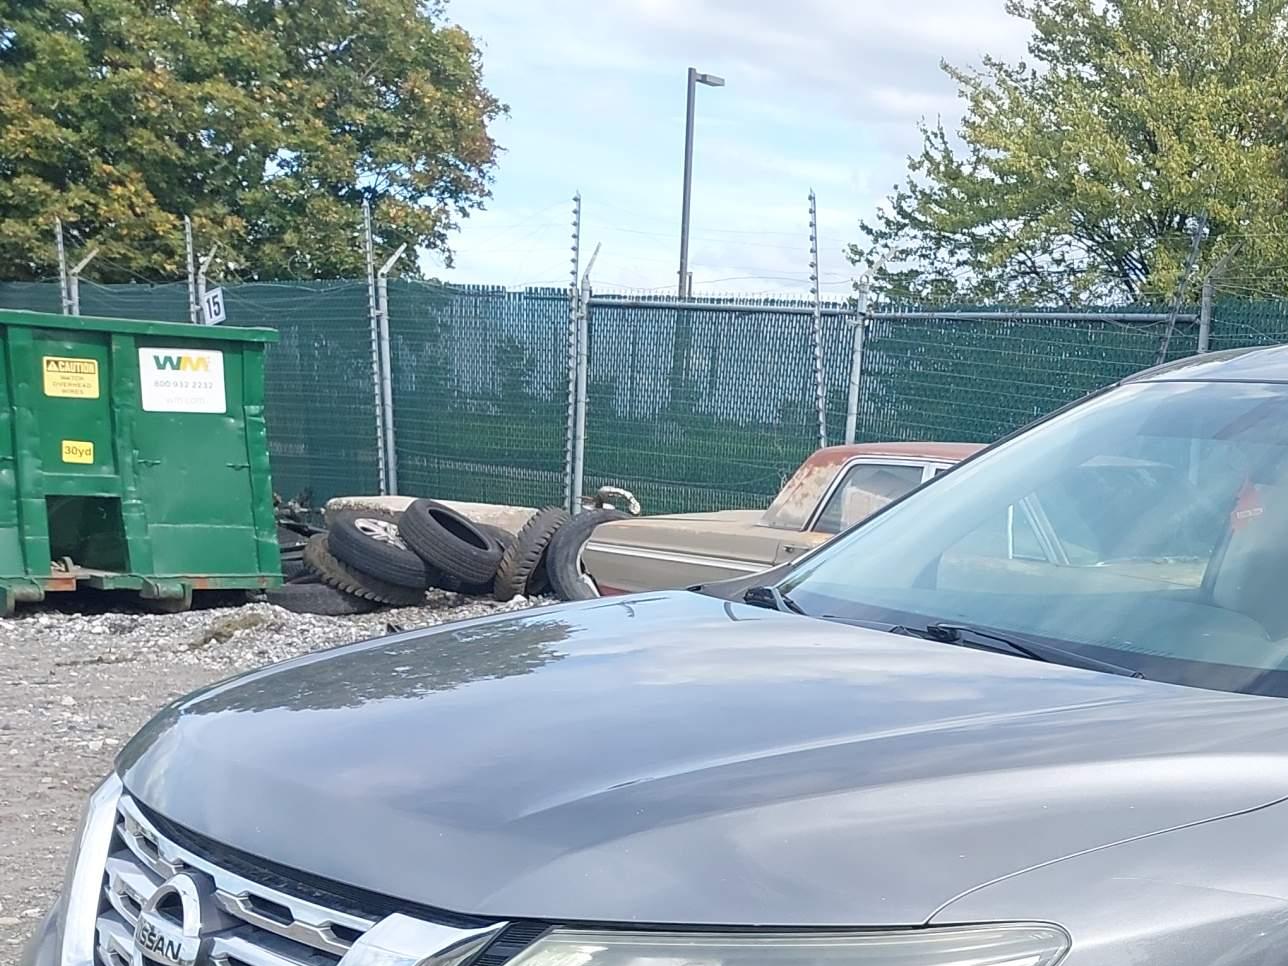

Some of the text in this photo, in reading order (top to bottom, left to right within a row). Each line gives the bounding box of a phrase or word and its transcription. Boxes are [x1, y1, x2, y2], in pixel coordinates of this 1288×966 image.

[206, 294, 220, 319] 15
[58, 361, 96, 373] CAUTION
[153, 354, 209, 372] WM
[64, 446, 92, 457] 30yd
